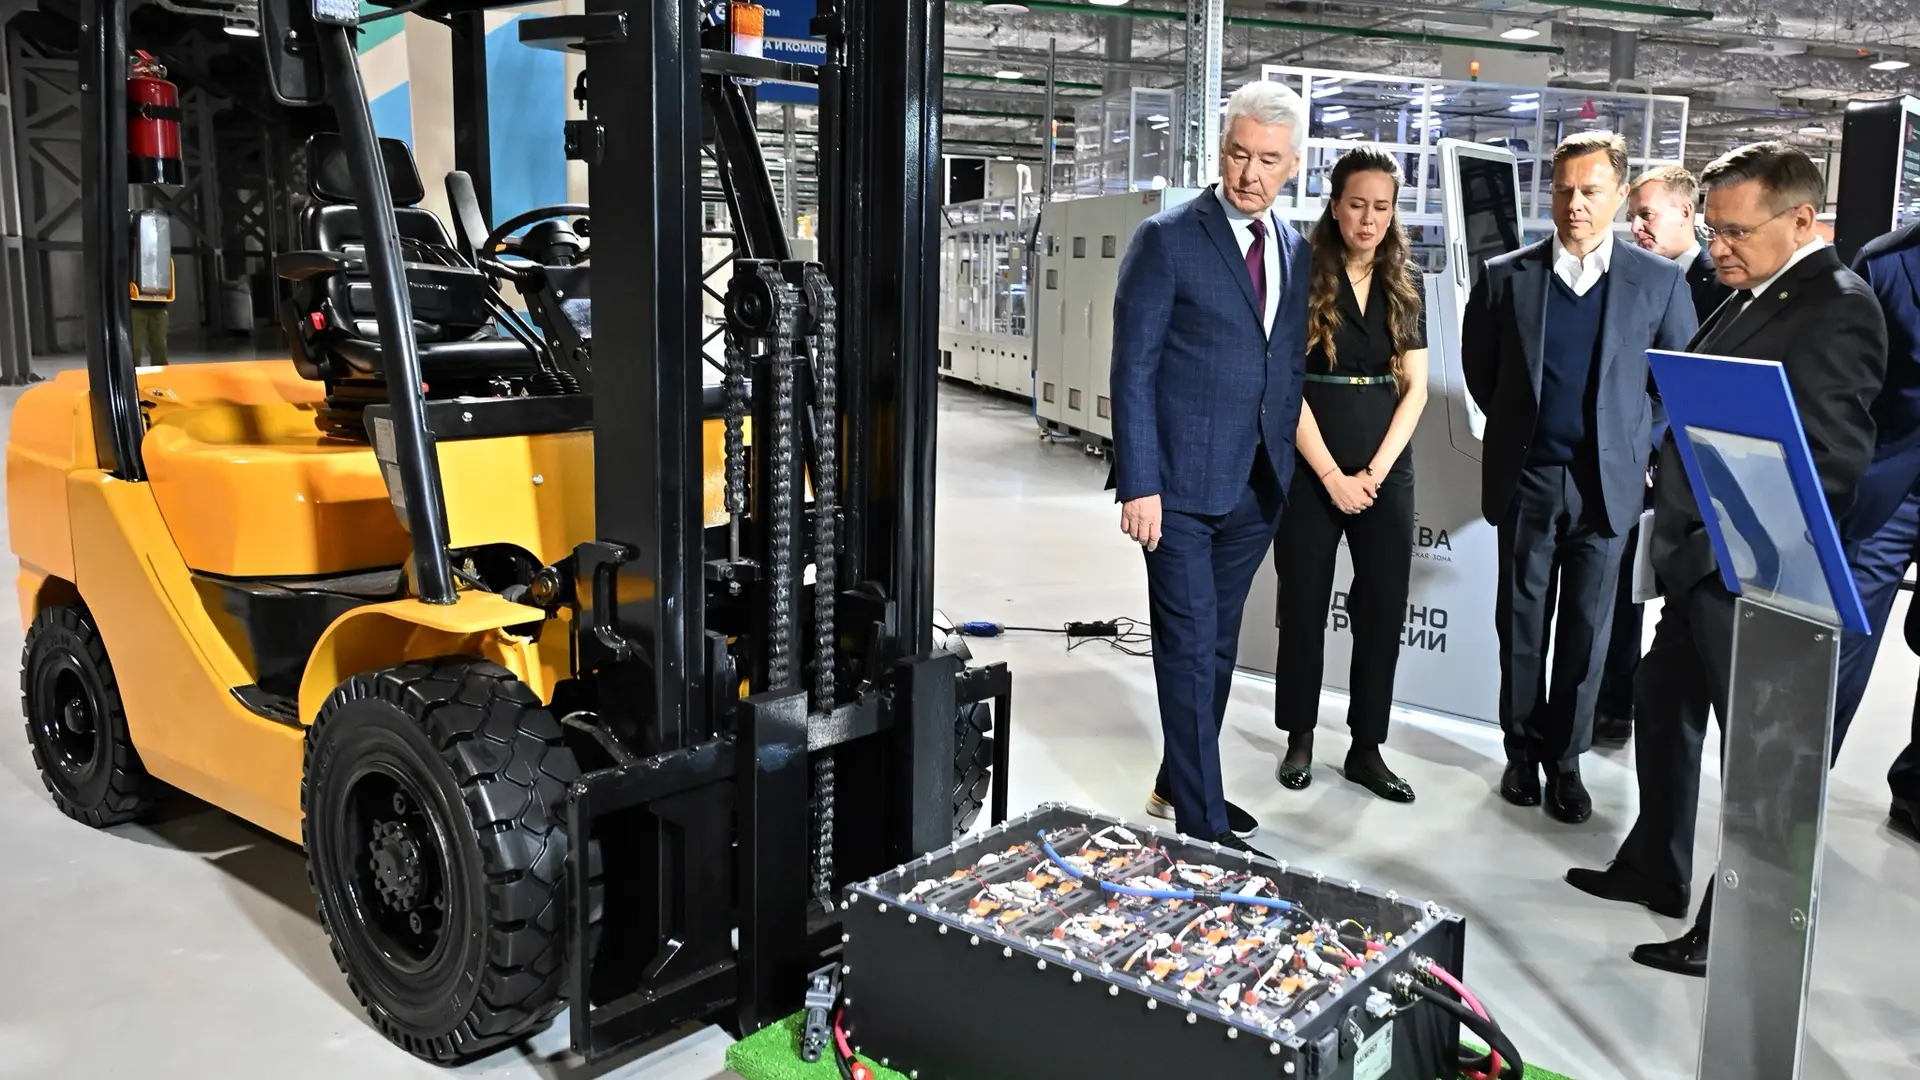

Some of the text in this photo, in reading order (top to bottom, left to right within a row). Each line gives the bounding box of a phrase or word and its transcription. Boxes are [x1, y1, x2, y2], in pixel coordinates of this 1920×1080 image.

[775, 42, 783, 51] И
[785, 42, 827, 54] КОМПО
[1412, 526, 1452, 551] ВА
[1432, 554, 1452, 562] ЗОНА
